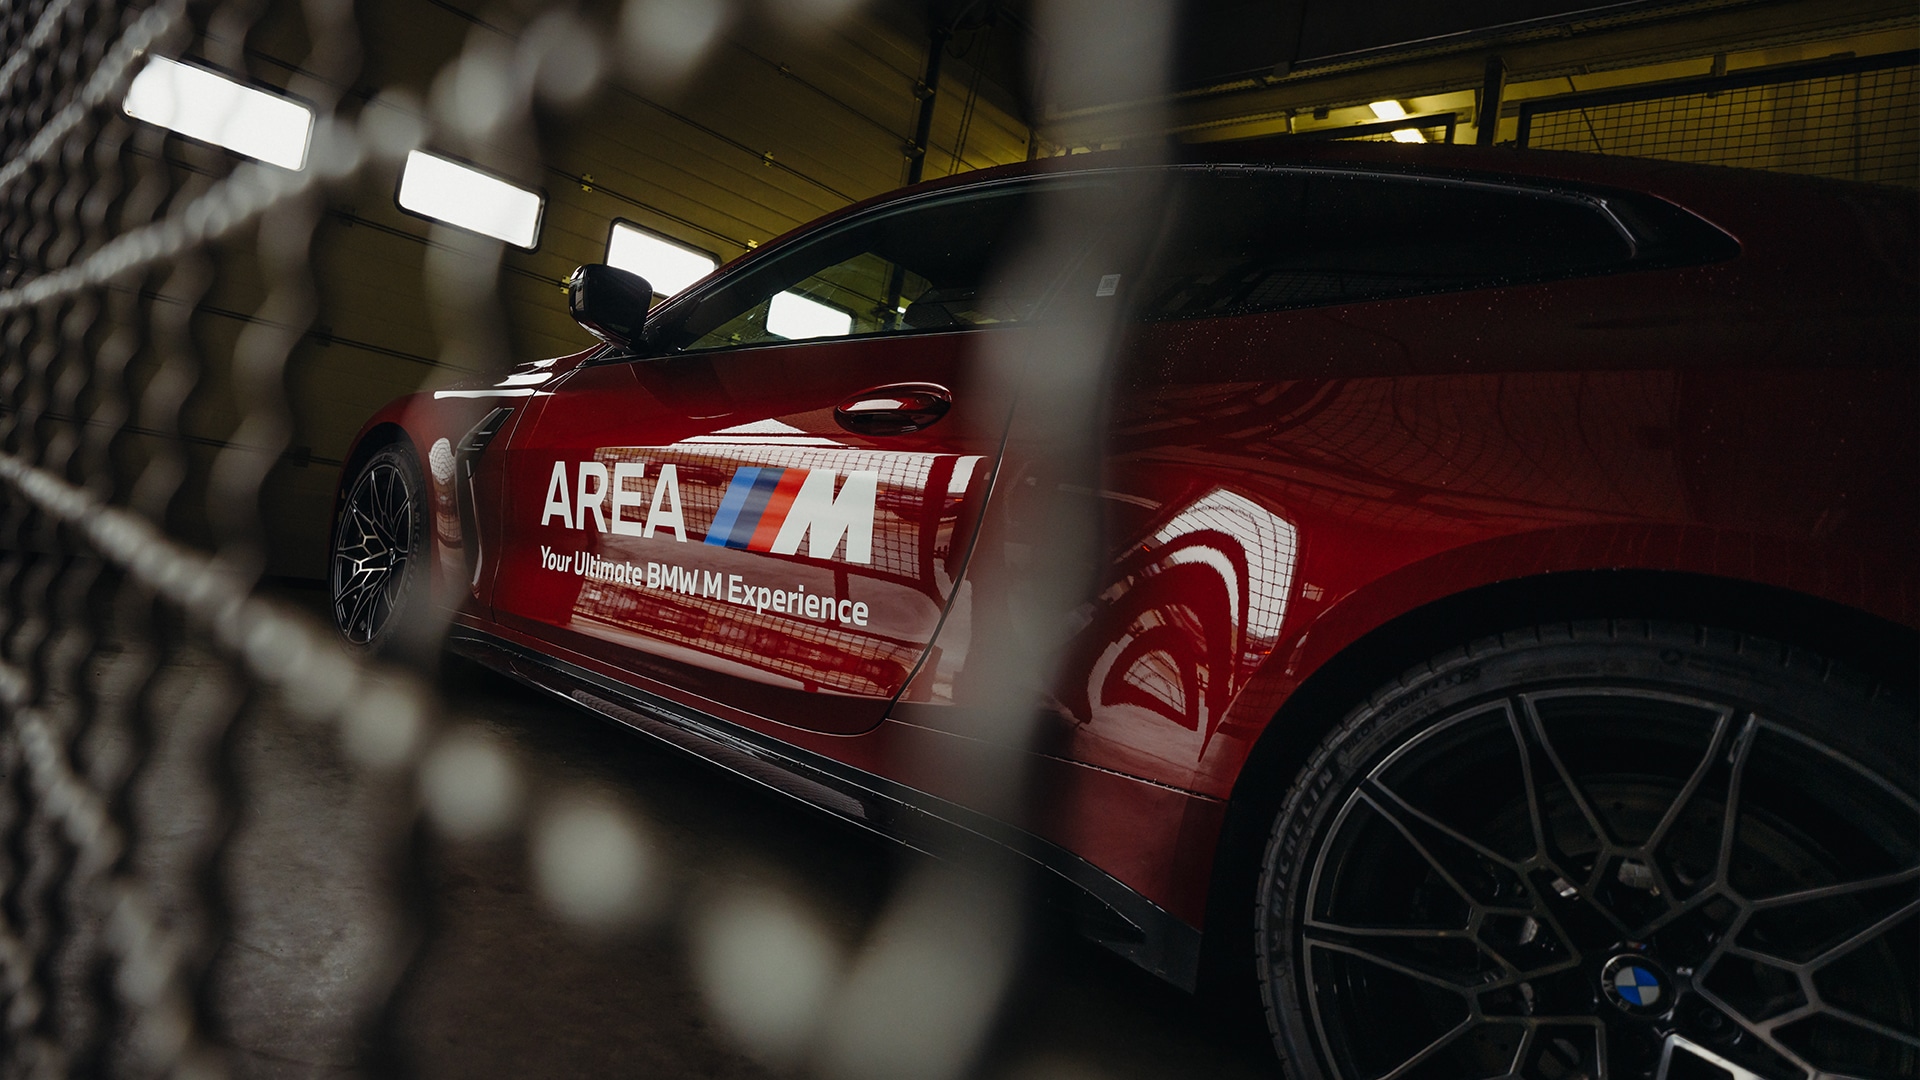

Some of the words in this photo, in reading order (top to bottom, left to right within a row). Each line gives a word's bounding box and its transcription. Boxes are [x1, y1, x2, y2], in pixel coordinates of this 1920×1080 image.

[541, 460, 688, 543] AREA
[770, 469, 878, 564] M
[540, 545, 573, 573] Your
[574, 550, 643, 586] Ultimate
[646, 561, 699, 596] BMW
[703, 571, 722, 600] M
[727, 573, 869, 627] Experience
[1272, 766, 1333, 918] MICHELIN
